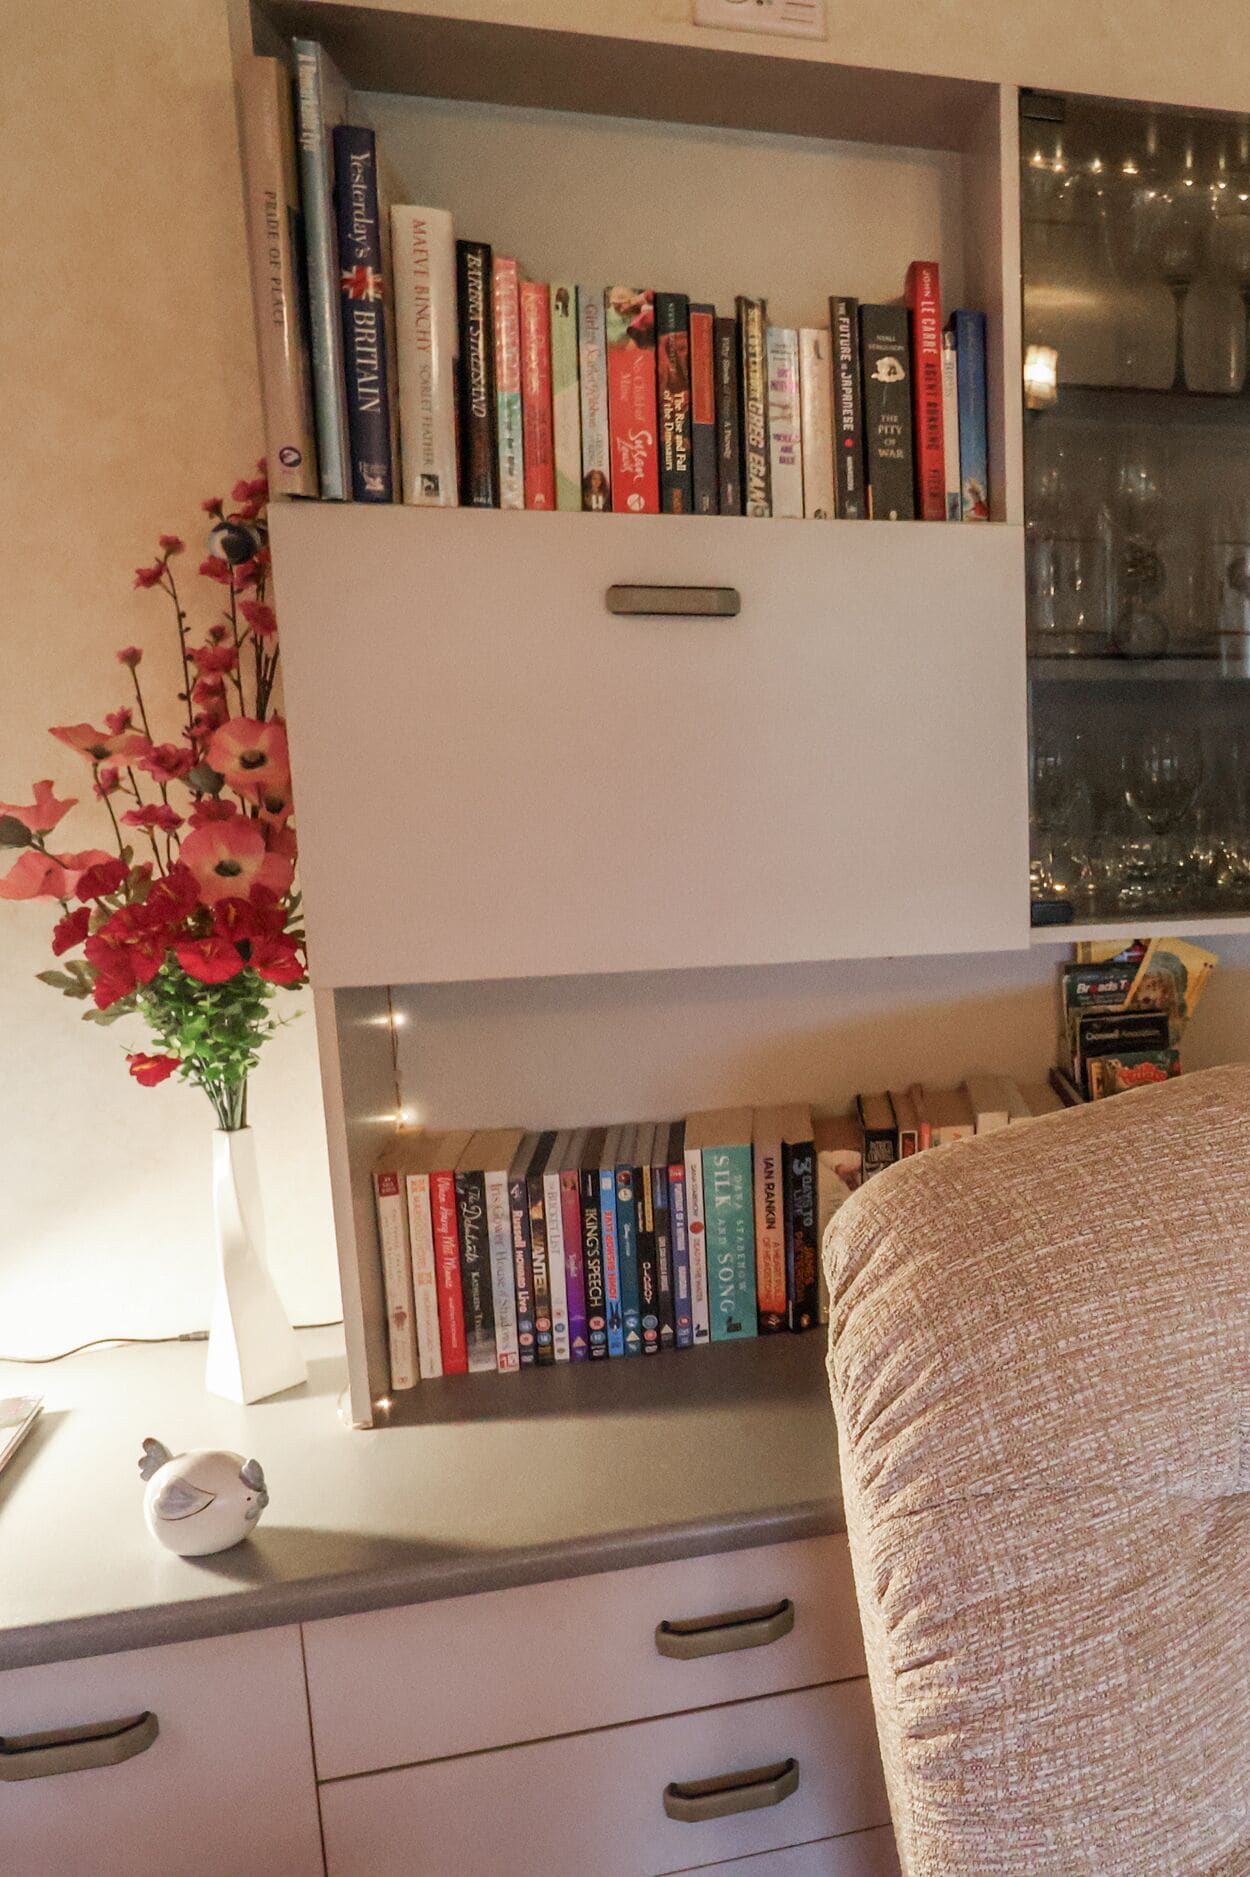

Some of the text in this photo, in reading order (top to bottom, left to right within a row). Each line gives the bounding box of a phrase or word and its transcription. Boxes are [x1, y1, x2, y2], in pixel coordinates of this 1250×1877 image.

[348, 152, 374, 258] Yesterday's
[265, 191, 284, 327] PRIDE OF PLACE
[412, 220, 432, 353] MAEVE BINCHY
[468, 253, 484, 320] BARBRA
[920, 301, 935, 313] LE
[922, 270, 931, 297] JOHN
[353, 310, 380, 414] BRITAIN
[838, 317, 851, 361] FUTURE
[840, 372, 854, 431] JAPANESE
[924, 363, 938, 397] AGENT
[420, 364, 435, 466] SCARLET FEATHER
[663, 390, 674, 471] of the Dinosaurs
[674, 391, 687, 471] The Rise and Fall
[878, 425, 903, 435] PITY
[880, 415, 898, 423] THE
[926, 401, 940, 449] RUNNING
[628, 429, 653, 483] Susan
[748, 400, 768, 504] GREG EGAN
[878, 449, 904, 458] WAR
[884, 438, 896, 446] OF
[792, 1156, 812, 1175] 3
[491, 1183, 504, 1201] Iris
[763, 1157, 776, 1229] IAN RANKIN
[802, 1175, 814, 1227] DAYS TO
[491, 1205, 506, 1245] Gower
[513, 1210, 525, 1248] Russell
[713, 1155, 736, 1313] SILK AND SONG
[496, 1252, 508, 1287] House
[587, 1259, 602, 1307] SPEECH
[518, 1291, 529, 1313] Live
